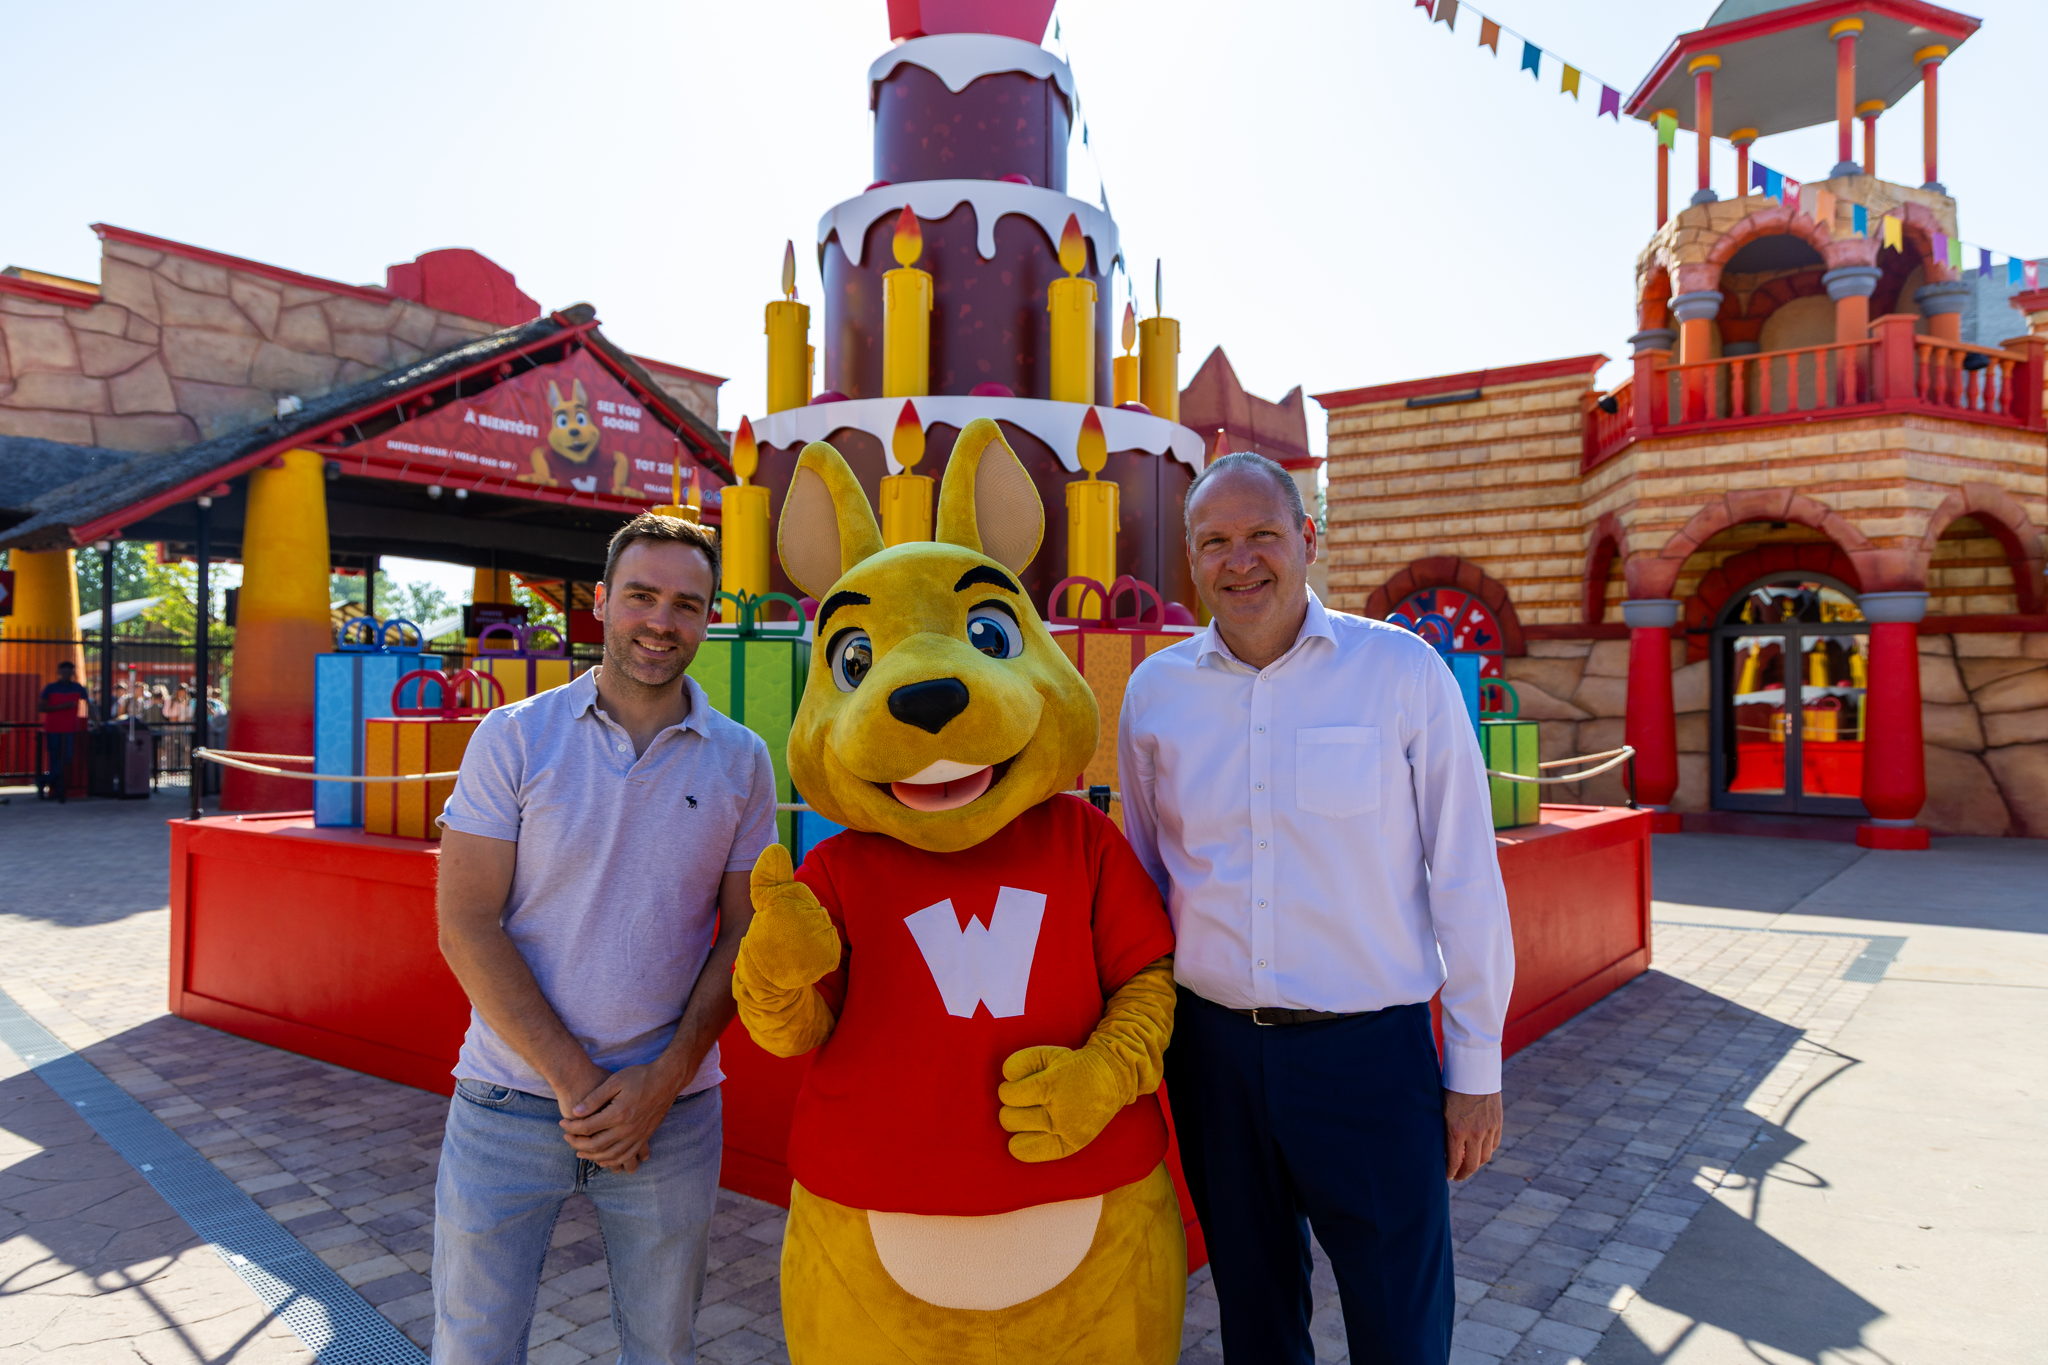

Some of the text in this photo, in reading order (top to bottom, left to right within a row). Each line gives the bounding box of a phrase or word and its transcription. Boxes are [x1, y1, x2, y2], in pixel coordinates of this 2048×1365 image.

[597, 400, 642, 419] SEE YOU
[602, 416, 640, 433] SOON!
[657, 462, 693, 480] ZIES!
[903, 886, 1047, 1019] W
